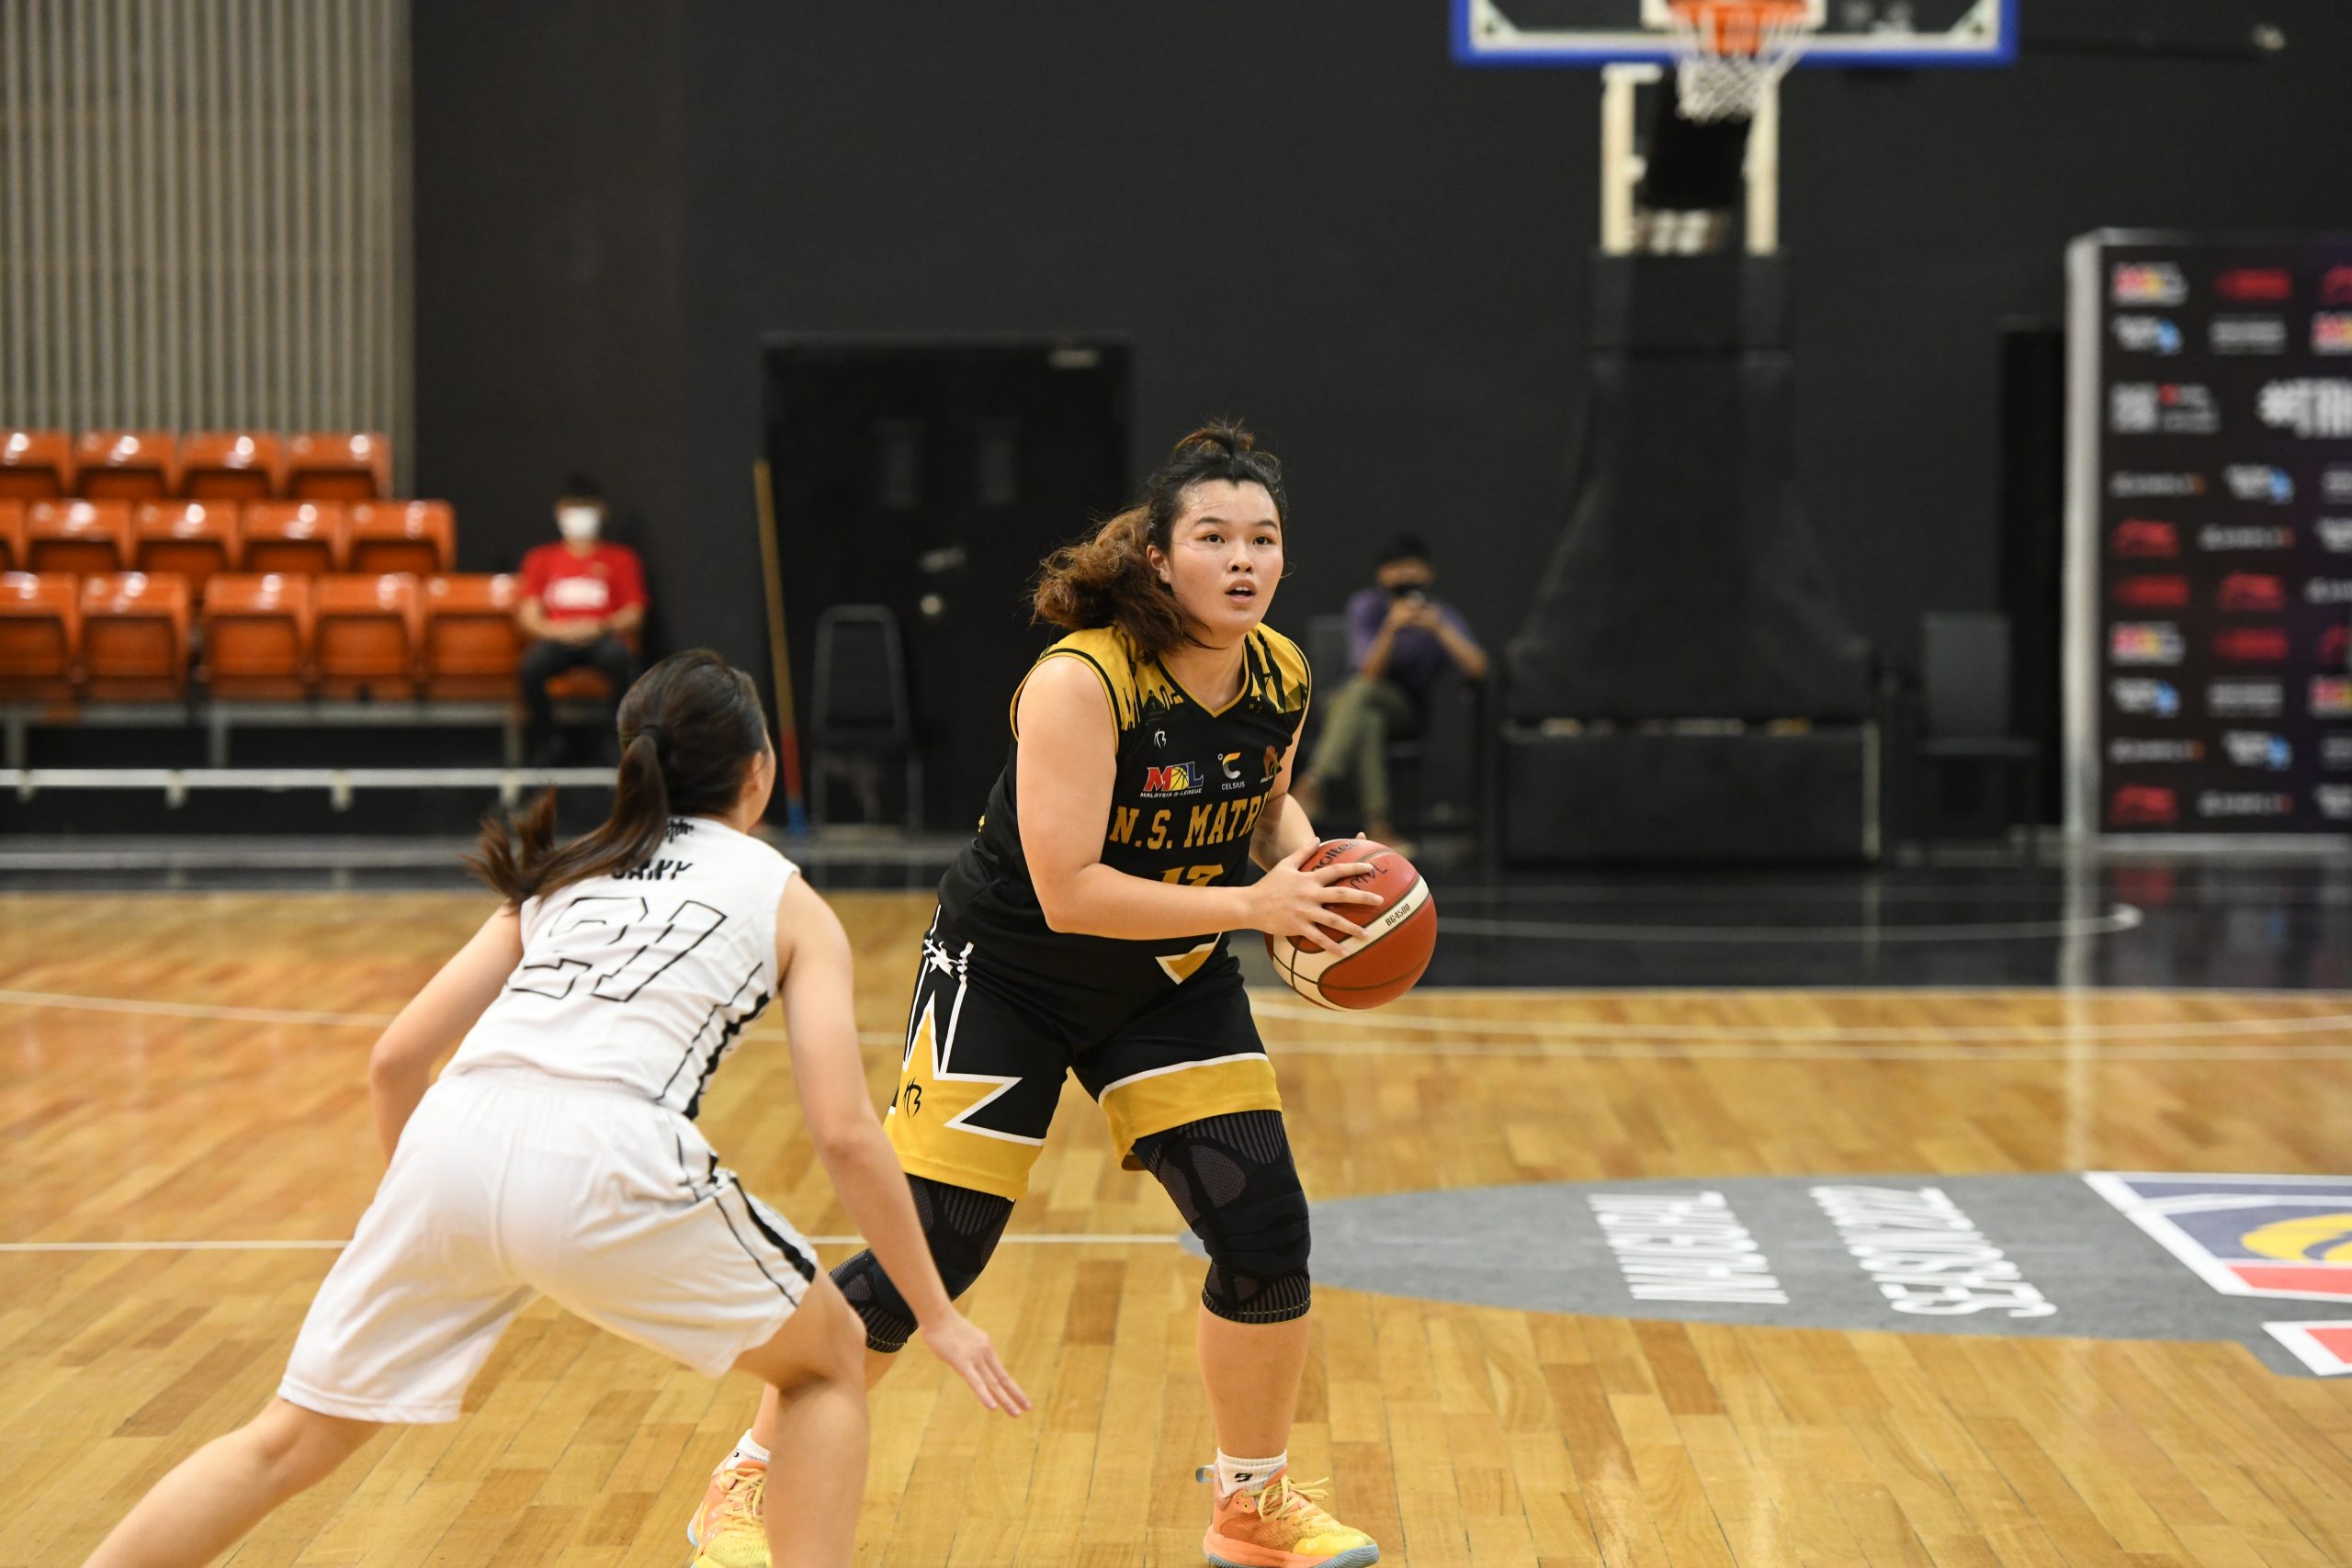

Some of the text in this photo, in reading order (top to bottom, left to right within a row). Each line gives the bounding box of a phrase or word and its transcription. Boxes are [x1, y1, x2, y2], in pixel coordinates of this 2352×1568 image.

[1221, 781, 1246, 791] CELSIUS
[1108, 806, 1173, 851] N.S.
[1385, 903, 1411, 927] BG4500
[1838, 1227, 2059, 1318] SEASON
